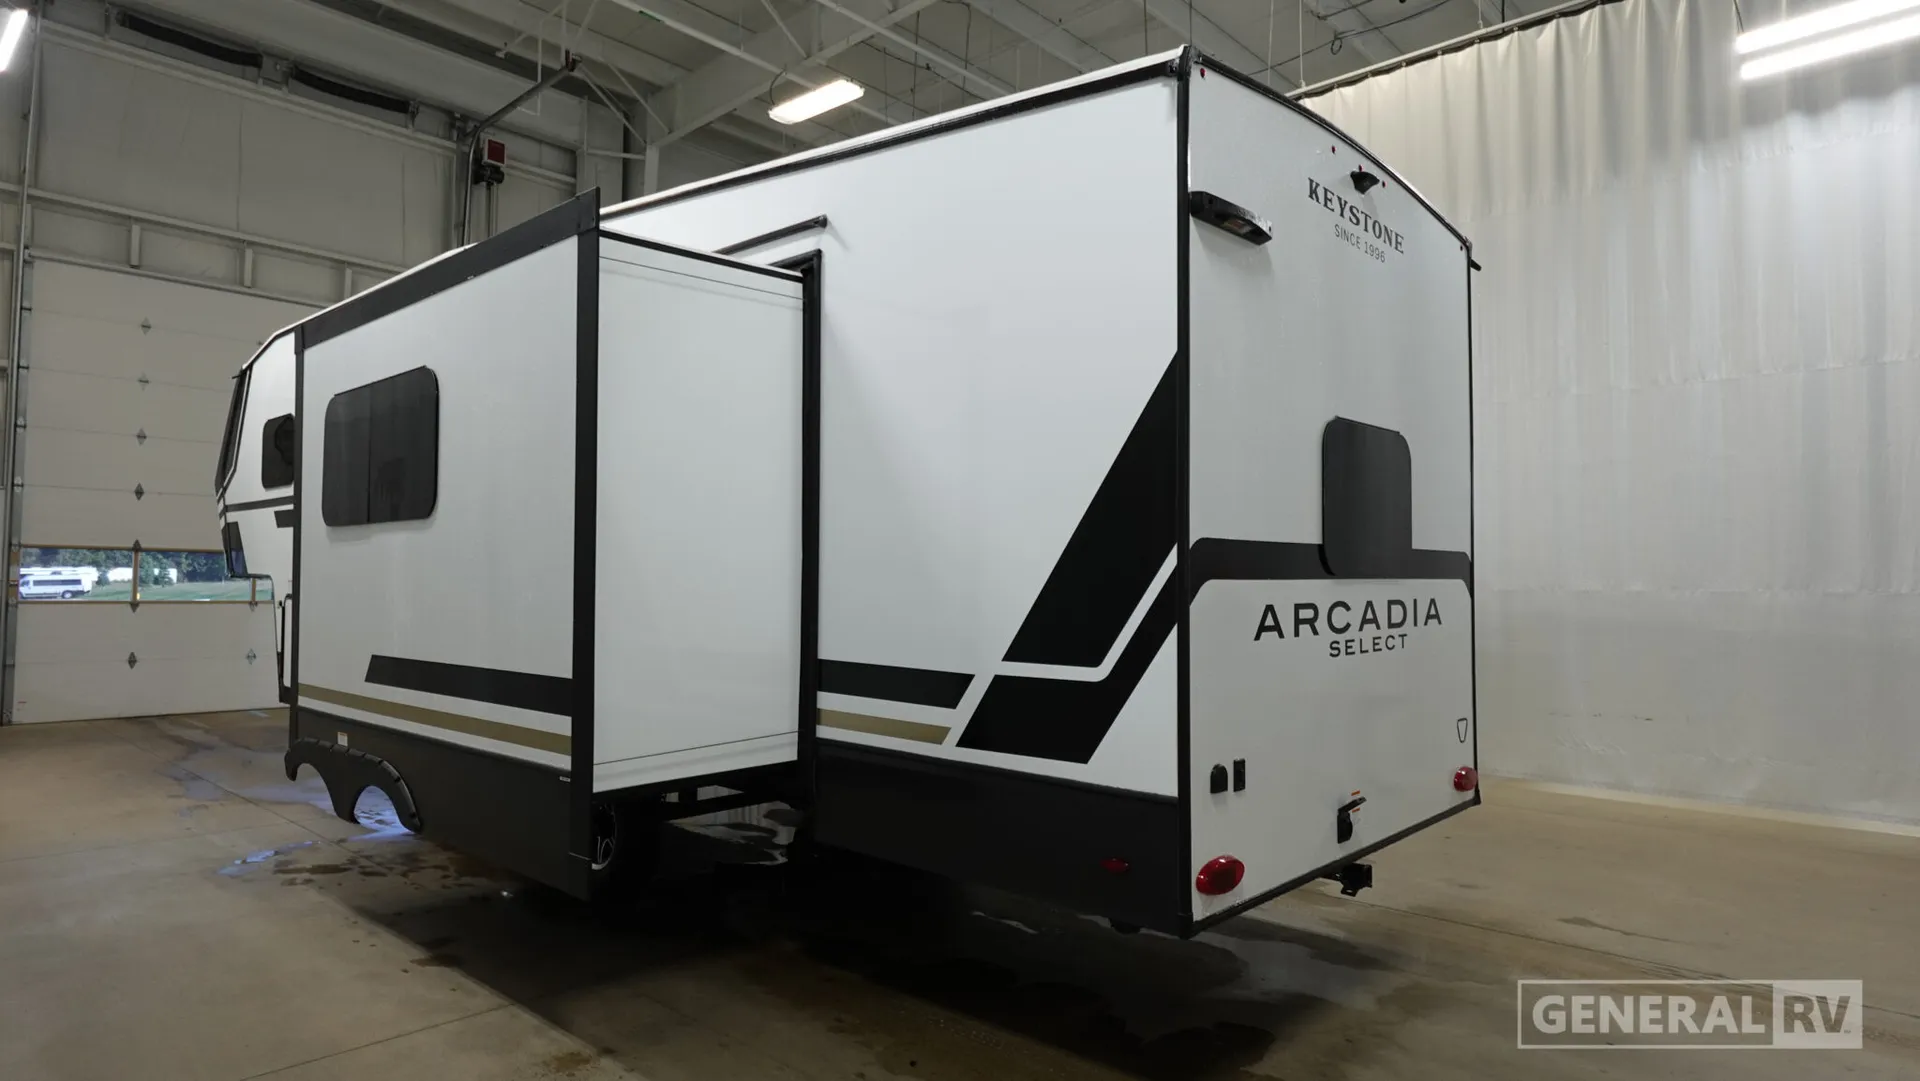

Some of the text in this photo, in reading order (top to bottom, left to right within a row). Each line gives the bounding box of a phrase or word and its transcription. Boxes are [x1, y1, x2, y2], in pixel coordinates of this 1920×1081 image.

[1308, 177, 1404, 254] KEYSTONE
[1334, 223, 1386, 263] SINCE 1996
[1253, 598, 1442, 641] ARCADIA
[1329, 633, 1408, 658] SELECT
